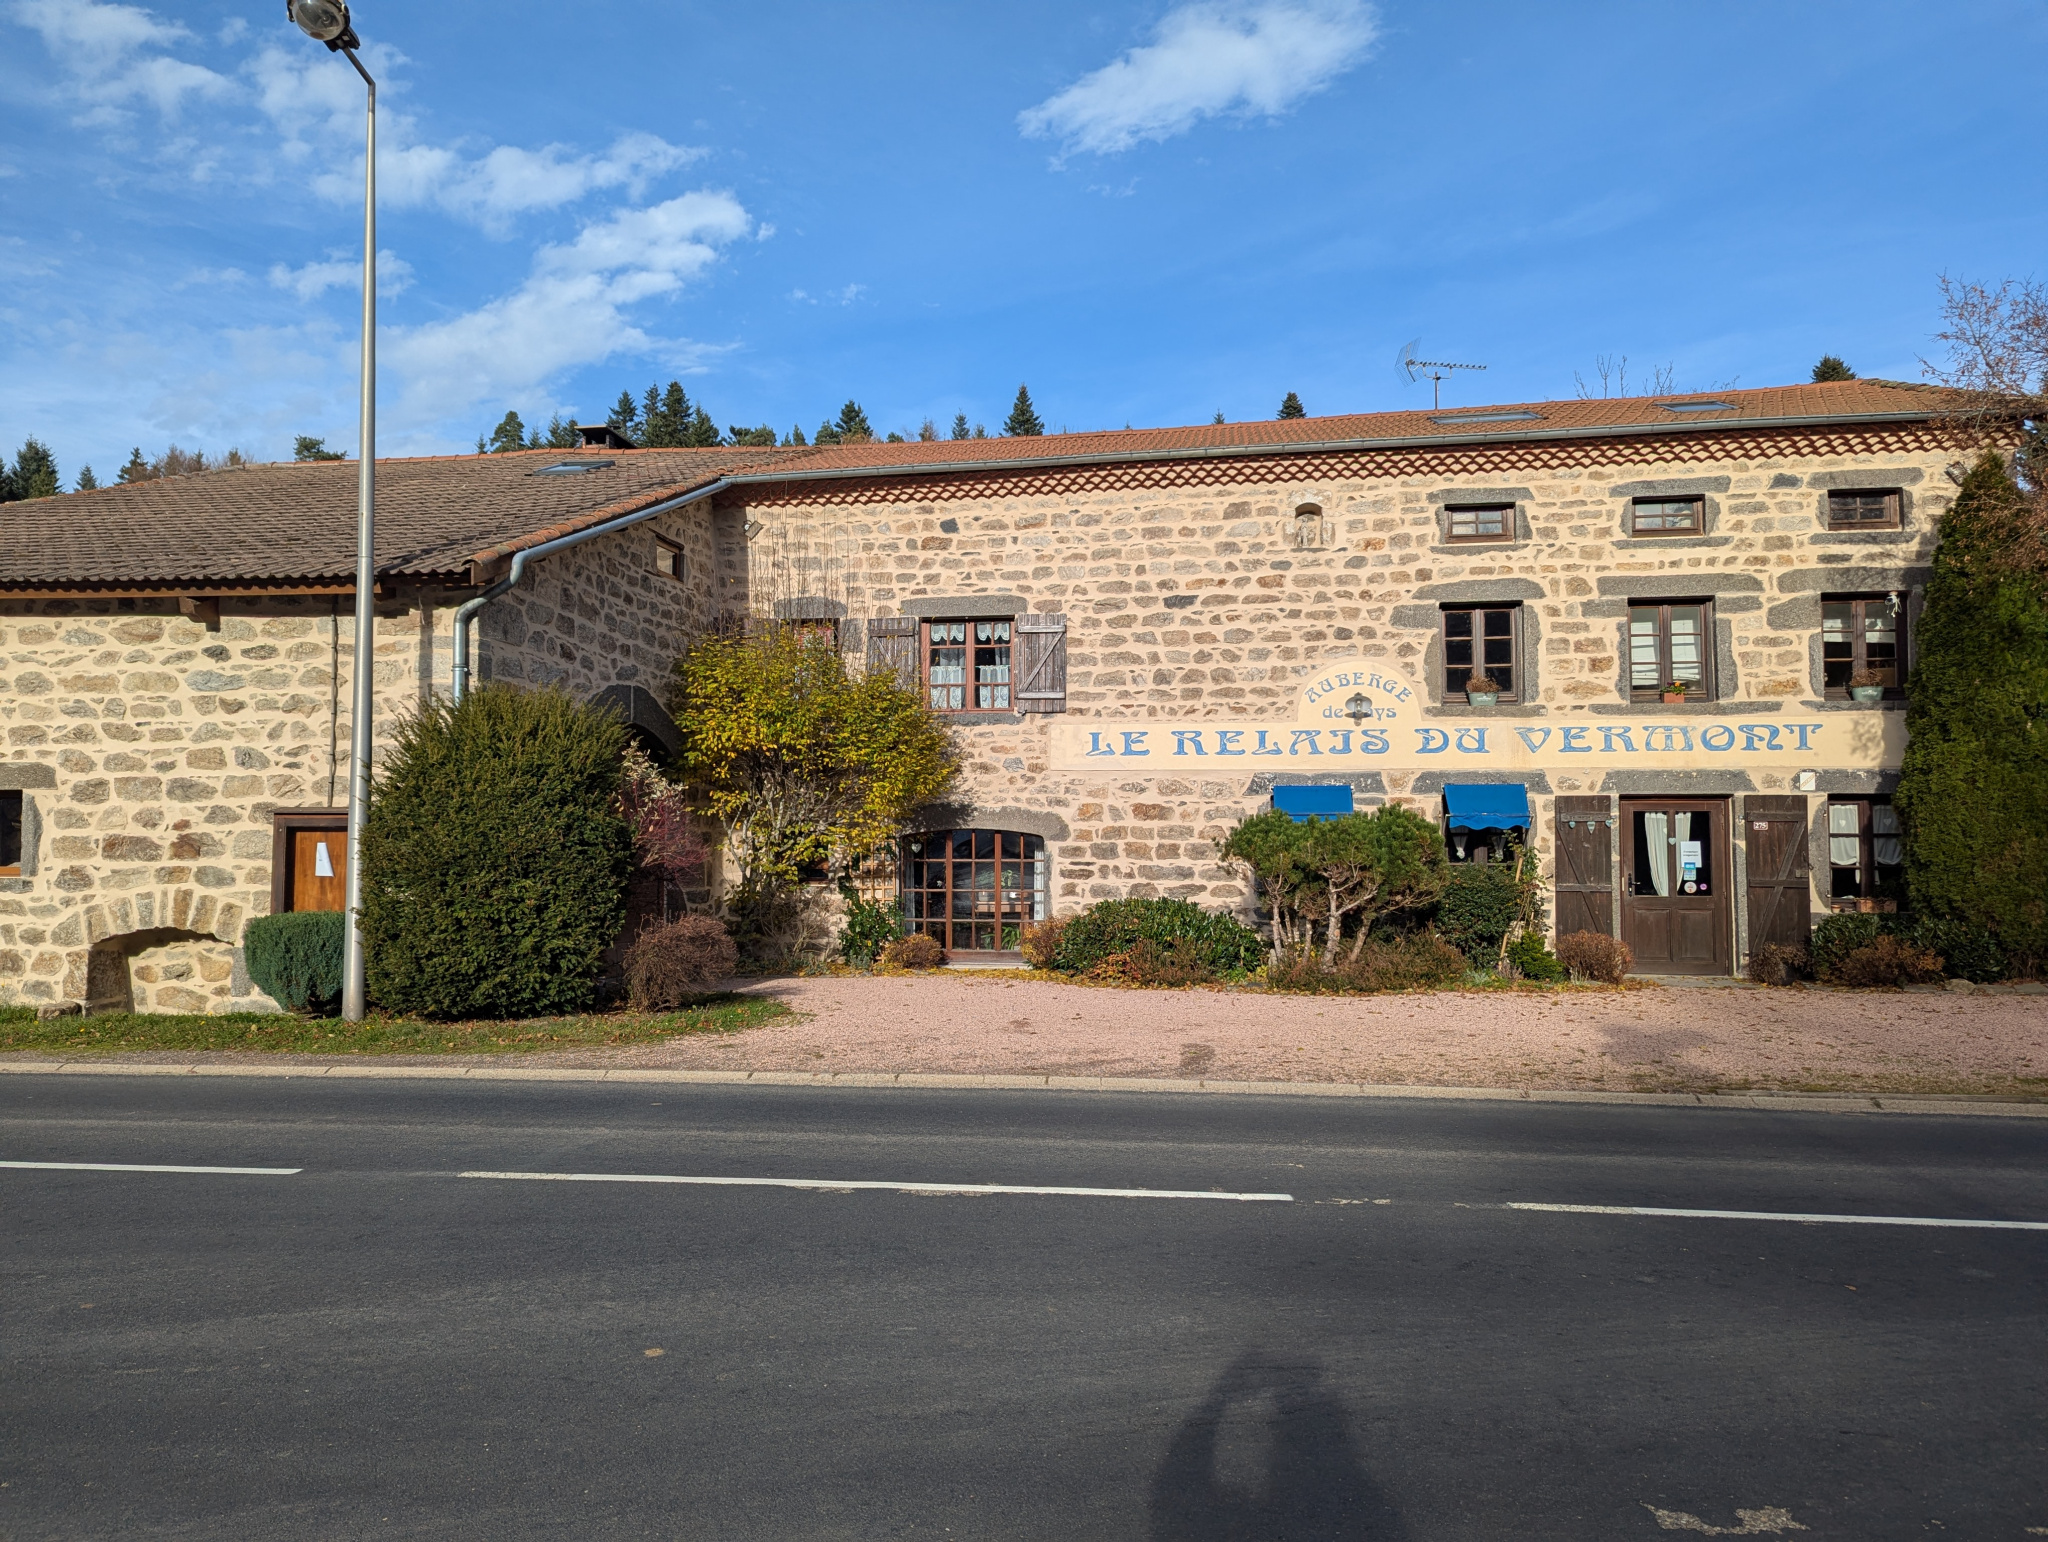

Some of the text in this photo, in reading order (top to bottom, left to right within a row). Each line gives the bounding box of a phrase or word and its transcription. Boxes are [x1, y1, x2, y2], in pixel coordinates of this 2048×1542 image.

[1304, 672, 1413, 703] AUBERGE
[1322, 705, 1397, 721] de ays
[1085, 723, 1824, 756] LE RELAIS DU VERMONT
[1754, 822, 1767, 830] 275
